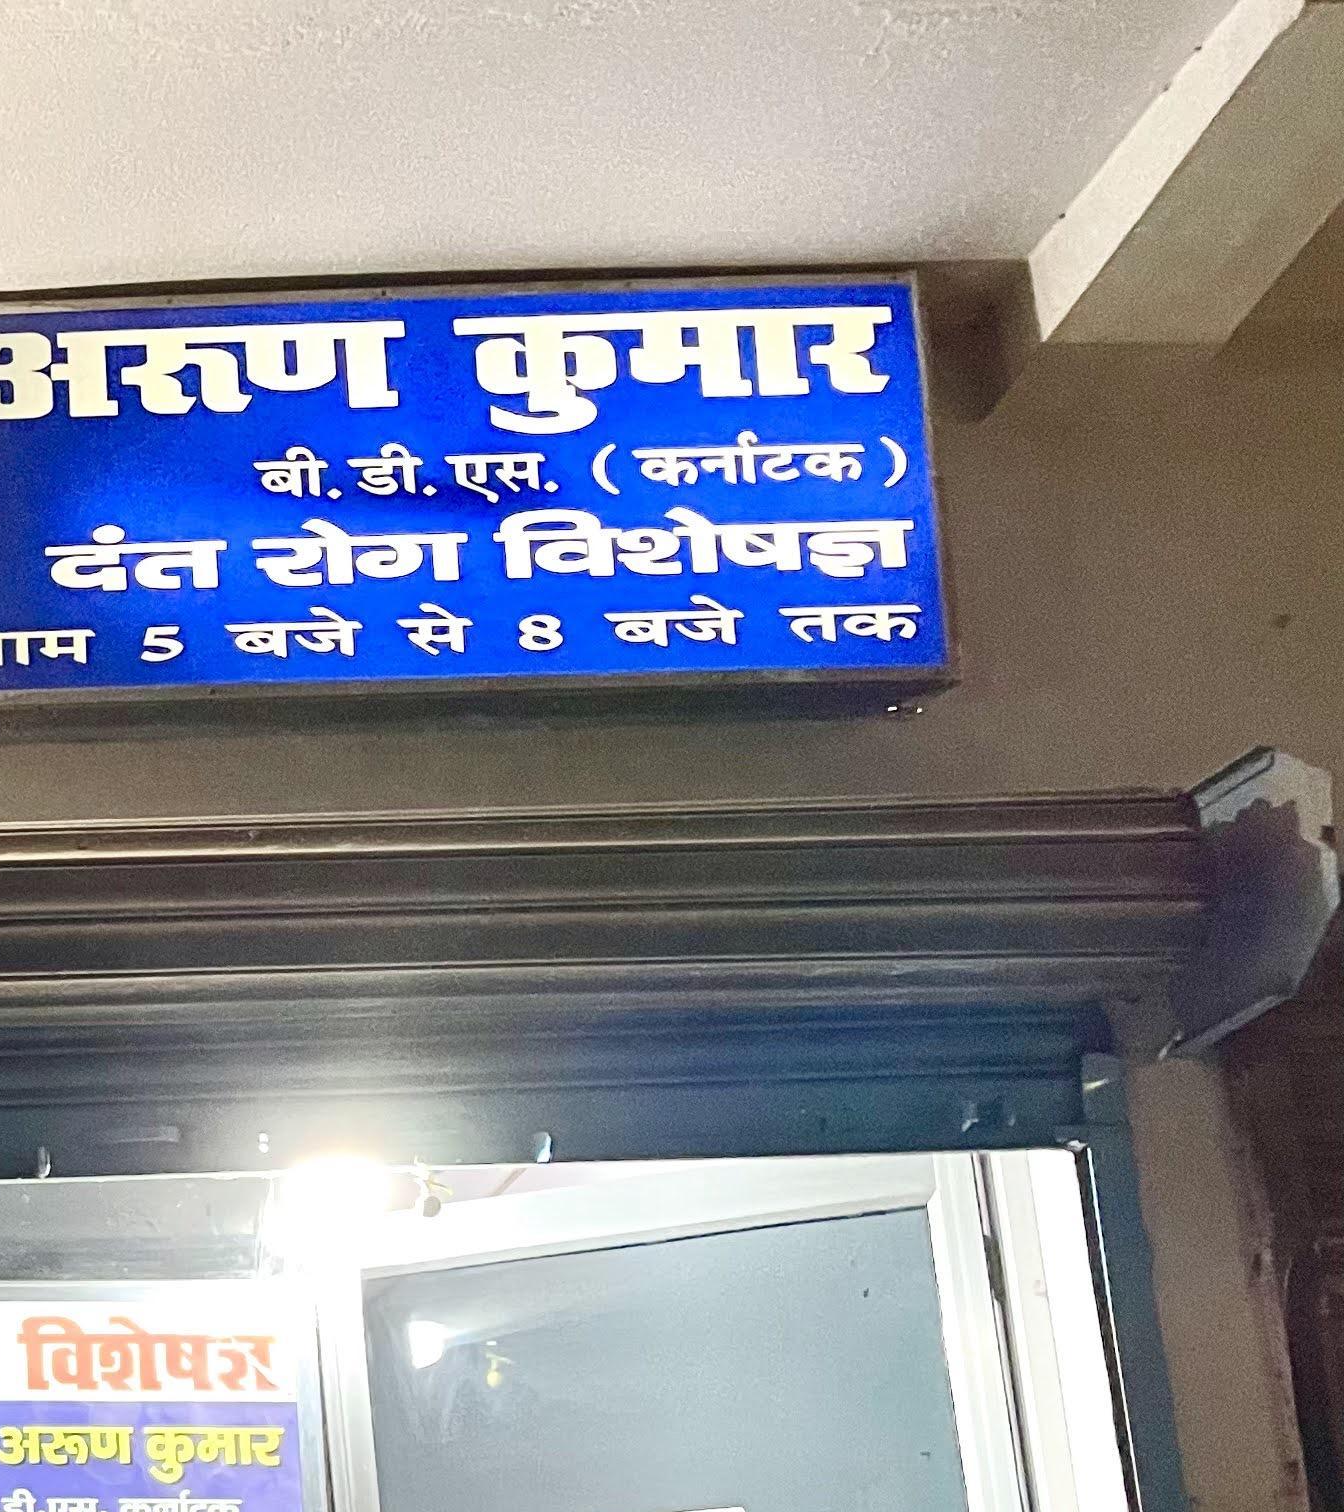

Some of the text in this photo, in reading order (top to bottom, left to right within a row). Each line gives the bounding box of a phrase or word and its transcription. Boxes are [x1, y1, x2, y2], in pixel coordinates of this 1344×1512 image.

[452, 306, 892, 436] कुमार
[44, 506, 915, 593] दंत रोग विशेषज्ञ
[140, 625, 184, 662] 5
[224, 606, 363, 658] बजे
[396, 602, 474, 656] से
[518, 614, 564, 651] 8
[603, 594, 745, 647] बजे
[778, 604, 922, 643] तक
[143, 1424, 285, 1484] कुमार
